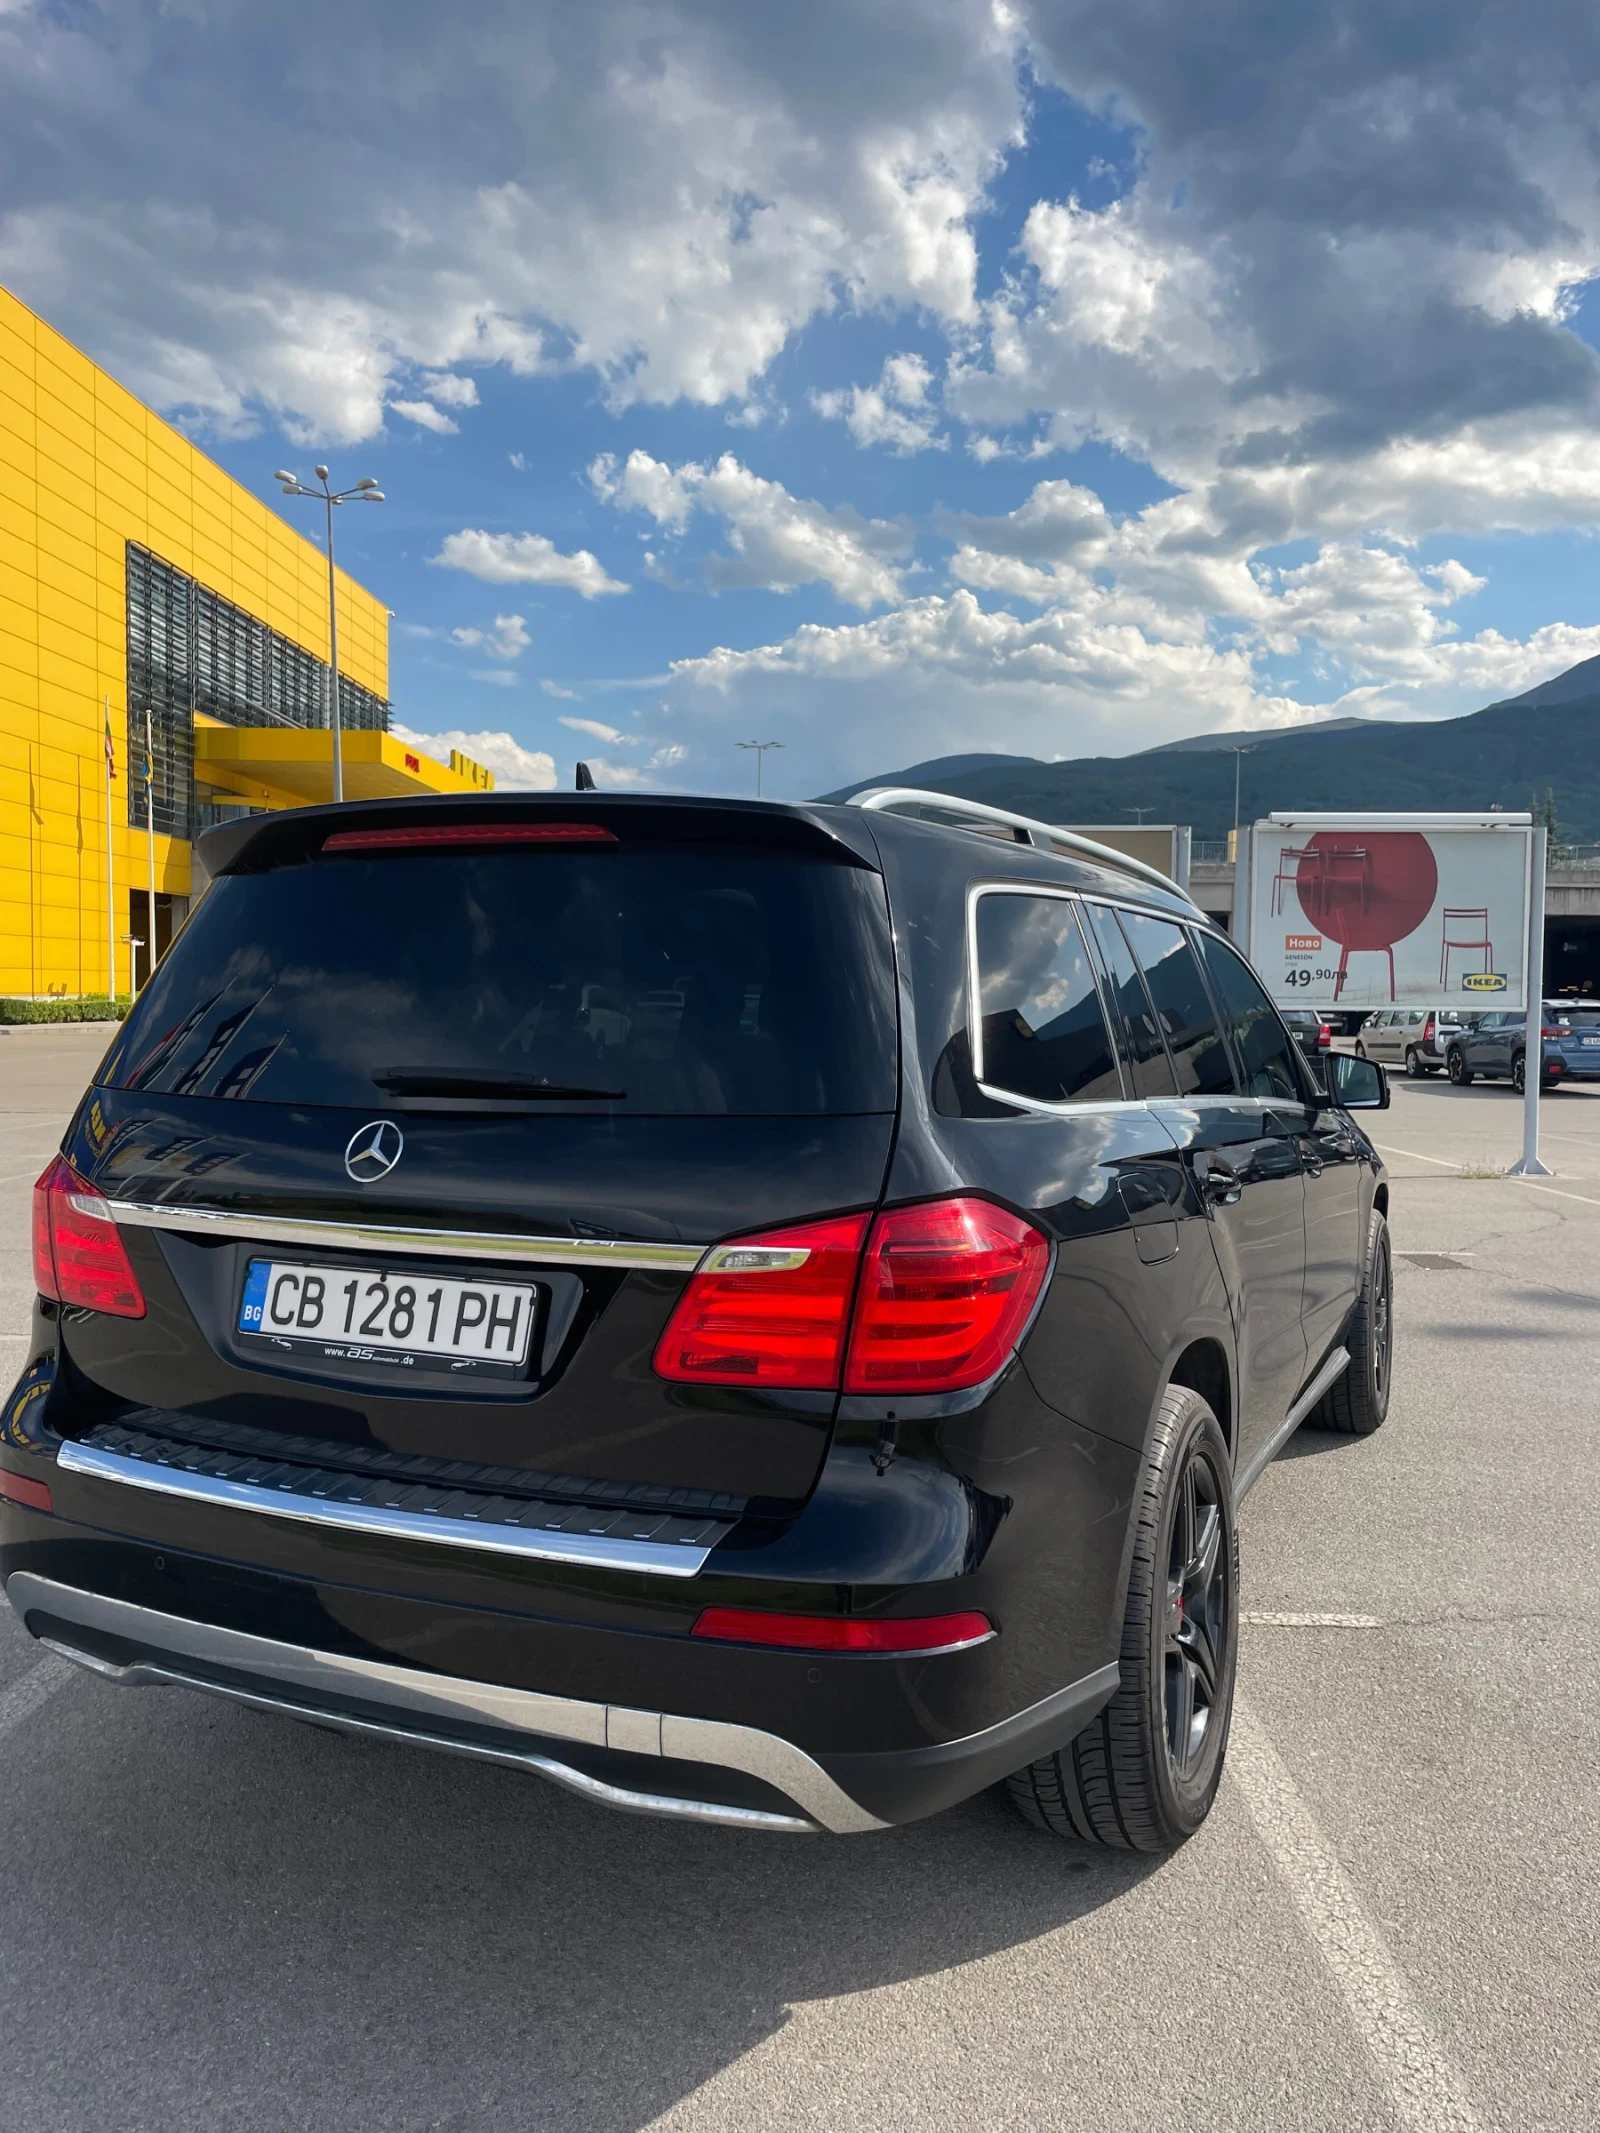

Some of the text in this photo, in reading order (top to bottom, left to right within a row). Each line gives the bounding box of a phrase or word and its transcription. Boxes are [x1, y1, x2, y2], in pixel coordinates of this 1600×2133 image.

[1289, 938, 1320, 948] Ново
[243, 1305, 262, 1321] BG
[270, 1274, 522, 1352] CB 1281 PH
